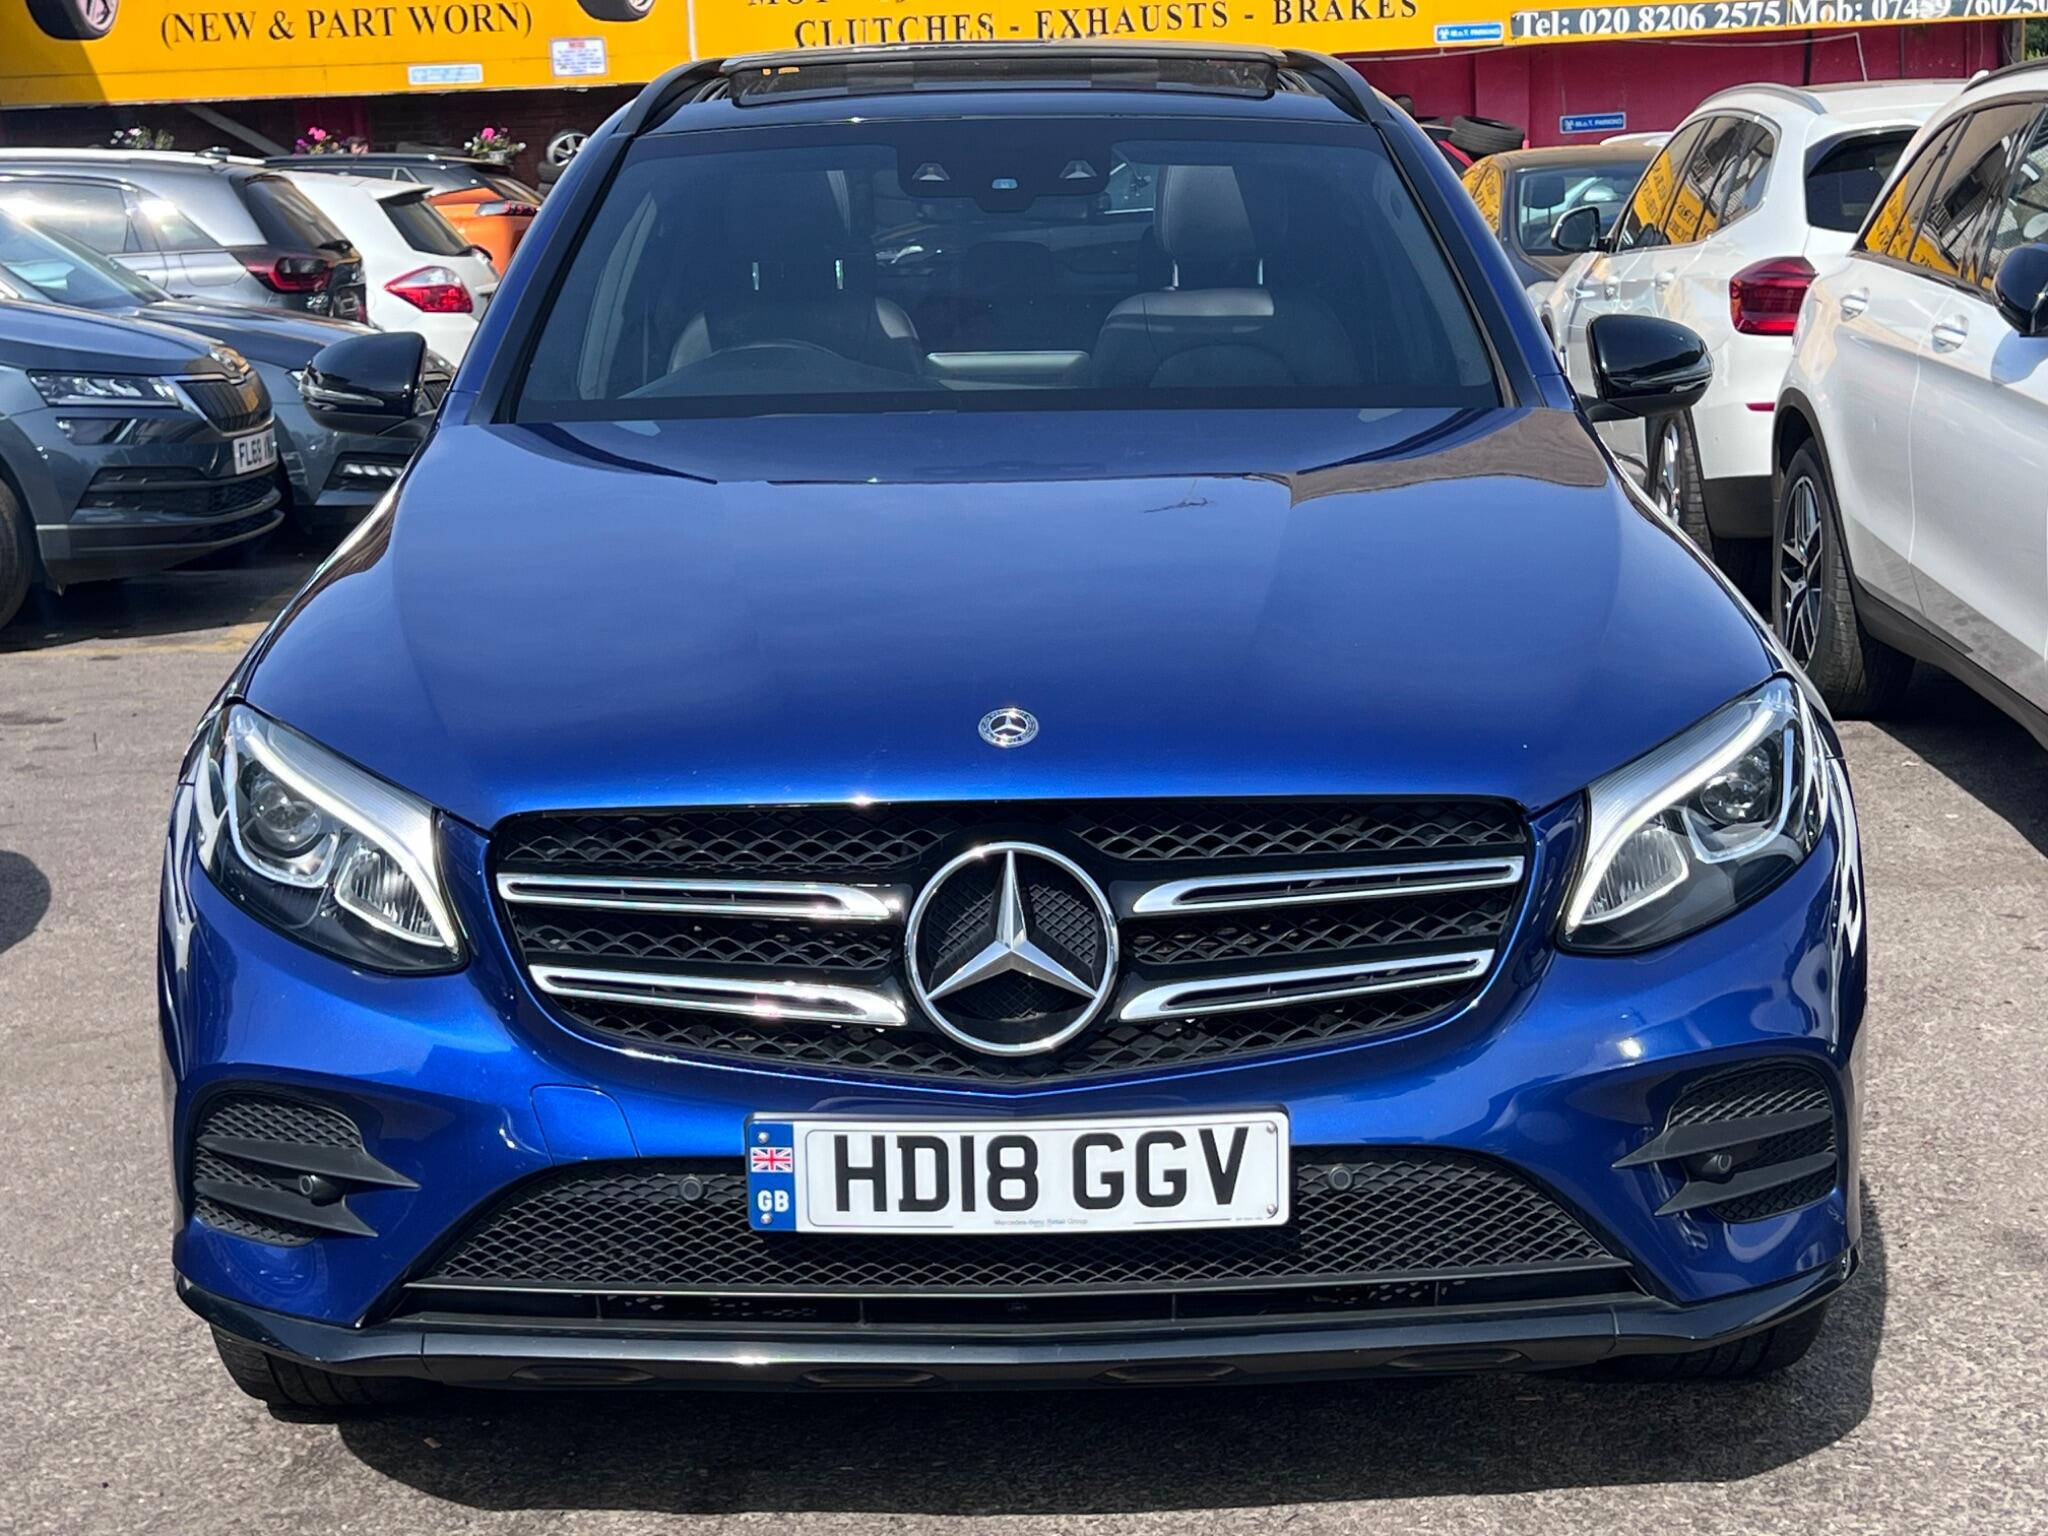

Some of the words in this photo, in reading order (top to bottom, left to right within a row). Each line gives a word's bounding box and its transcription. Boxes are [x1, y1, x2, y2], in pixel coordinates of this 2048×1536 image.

[161, 12, 256, 51] (NEW
[268, 10, 296, 40] &
[307, 7, 397, 38] PART
[406, 2, 532, 39] WORN)
[794, 13, 994, 47] CLUTCHES
[1035, 1, 1227, 39] EXHAUSTS
[1273, 0, 1417, 25] BRAKES
[1512, 11, 1570, 37] Tel:
[1579, 8, 1630, 34] 020
[1638, 5, 1706, 32] 8206
[1714, 1, 1781, 29] 2575
[1791, 0, 1862, 25] Mob:
[834, 1134, 1039, 1213] HD18
[1071, 1126, 1250, 1211] GGV
[757, 1190, 790, 1212] GB
